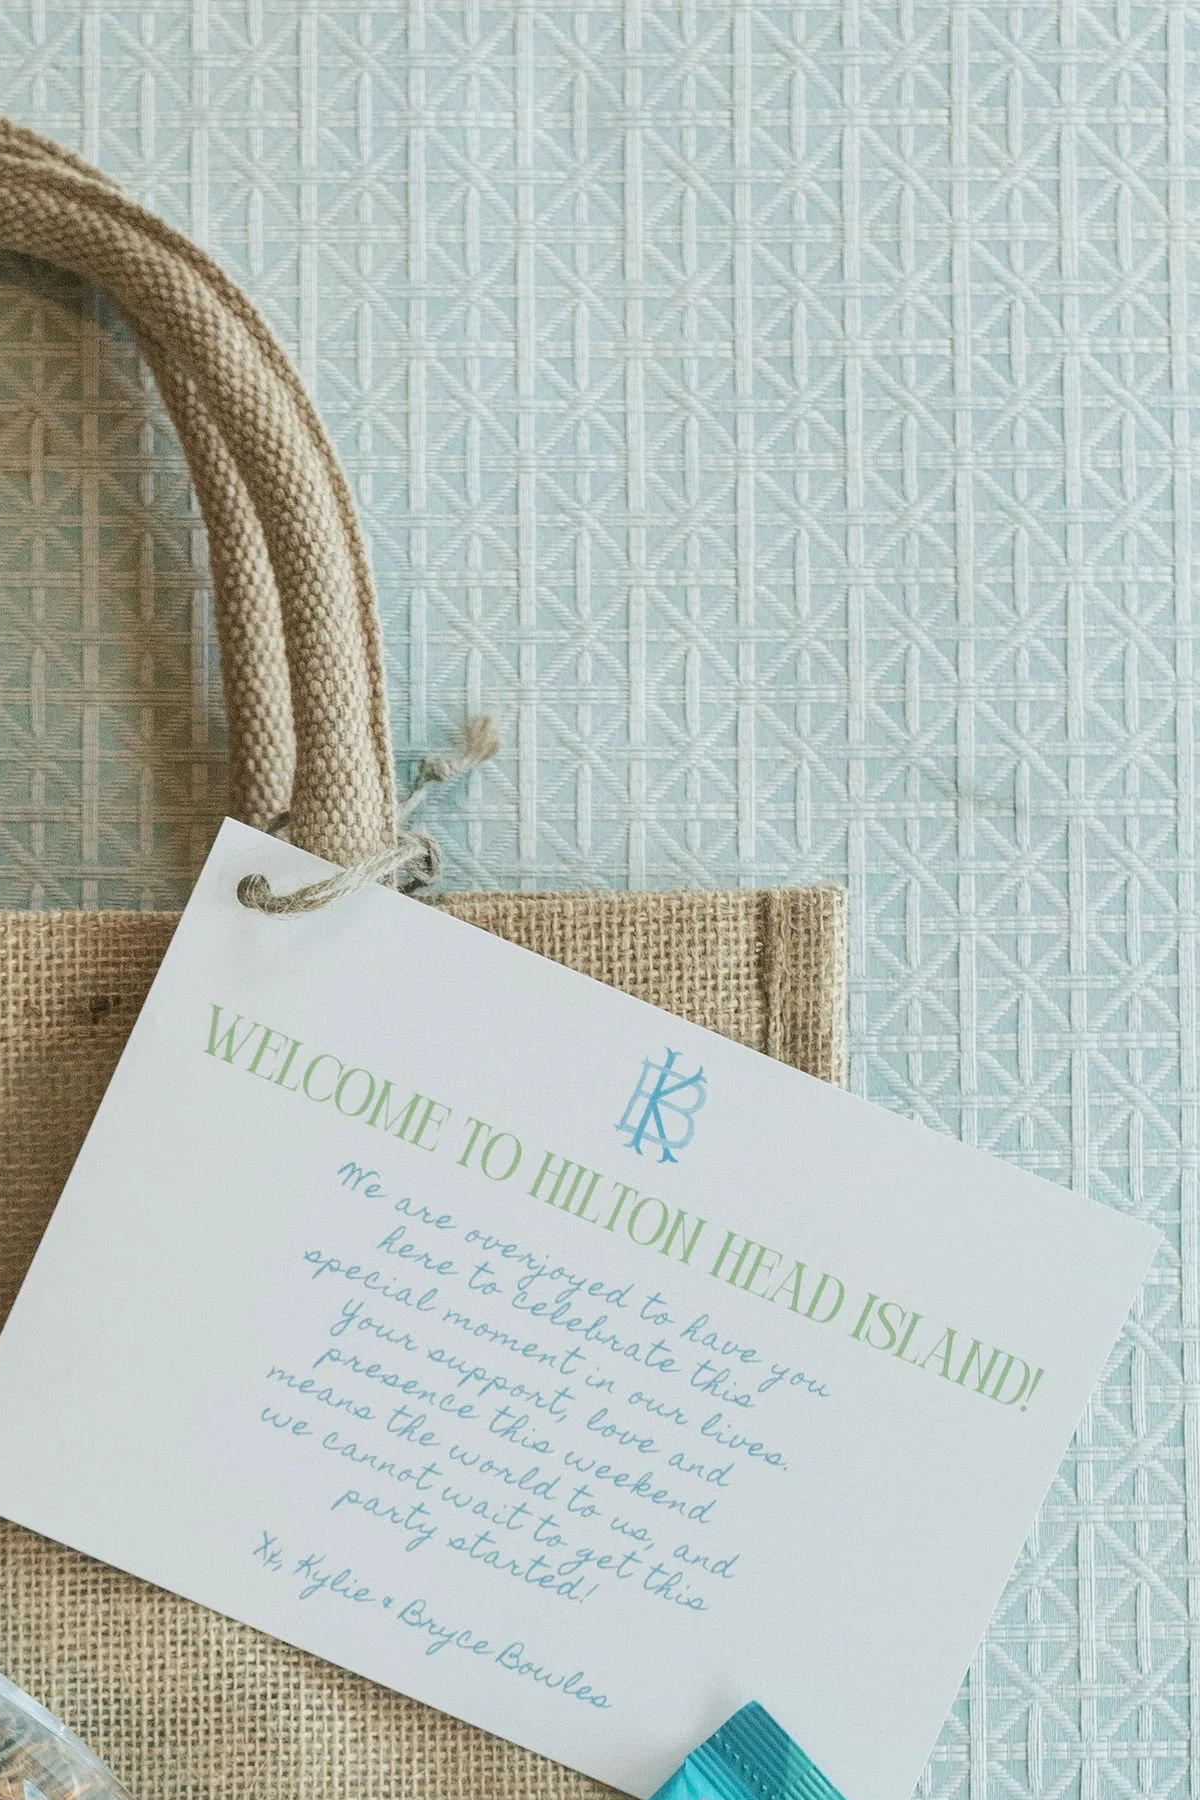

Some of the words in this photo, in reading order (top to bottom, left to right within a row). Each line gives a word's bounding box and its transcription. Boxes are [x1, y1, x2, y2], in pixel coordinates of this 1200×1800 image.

[202, 1003, 453, 1153] WELCOME
[455, 1116, 523, 1182] TO
[528, 1149, 709, 1266] HILTON
[709, 1230, 846, 1324] HEAD
[848, 1292, 1045, 1413] ISLAND!
[337, 1161, 389, 1199] We
[394, 1197, 458, 1231] are
[464, 1229, 635, 1309] overjoyed
[639, 1291, 675, 1328] to
[679, 1313, 763, 1366] have
[757, 1363, 832, 1398] you
[302, 1248, 438, 1313] special
[443, 1307, 587, 1376] moment
[585, 1366, 615, 1394] in
[628, 1390, 688, 1425] our
[700, 1413, 789, 1472] lives.
[330, 1298, 420, 1352] your
[427, 1347, 577, 1423] support,
[586, 1408, 661, 1454] love
[667, 1451, 736, 1487] and
[376, 1225, 460, 1276] here
[467, 1261, 503, 1296] to
[511, 1291, 683, 1374] celebrate
[689, 1360, 756, 1409] this
[260, 1407, 315, 1436] we
[321, 1431, 443, 1491] cannot
[441, 1485, 529, 1531] wait
[533, 1514, 568, 1548] to
[557, 1547, 643, 1578] get
[643, 1562, 710, 1612] this
[265, 1365, 377, 1421] means
[386, 1404, 441, 1447] the
[448, 1444, 563, 1502] world
[566, 1484, 602, 1518] to
[610, 1516, 656, 1551] us,
[673, 1543, 740, 1580] and
[312, 1346, 481, 1421] presence
[488, 1405, 555, 1455] this
[563, 1451, 718, 1525] weekend
[292, 1553, 376, 1600] Kylie
[396, 1599, 495, 1656] Bryce
[495, 1642, 614, 1710] Bowles
[330, 1490, 439, 1552] party
[447, 1531, 600, 1604] started!
